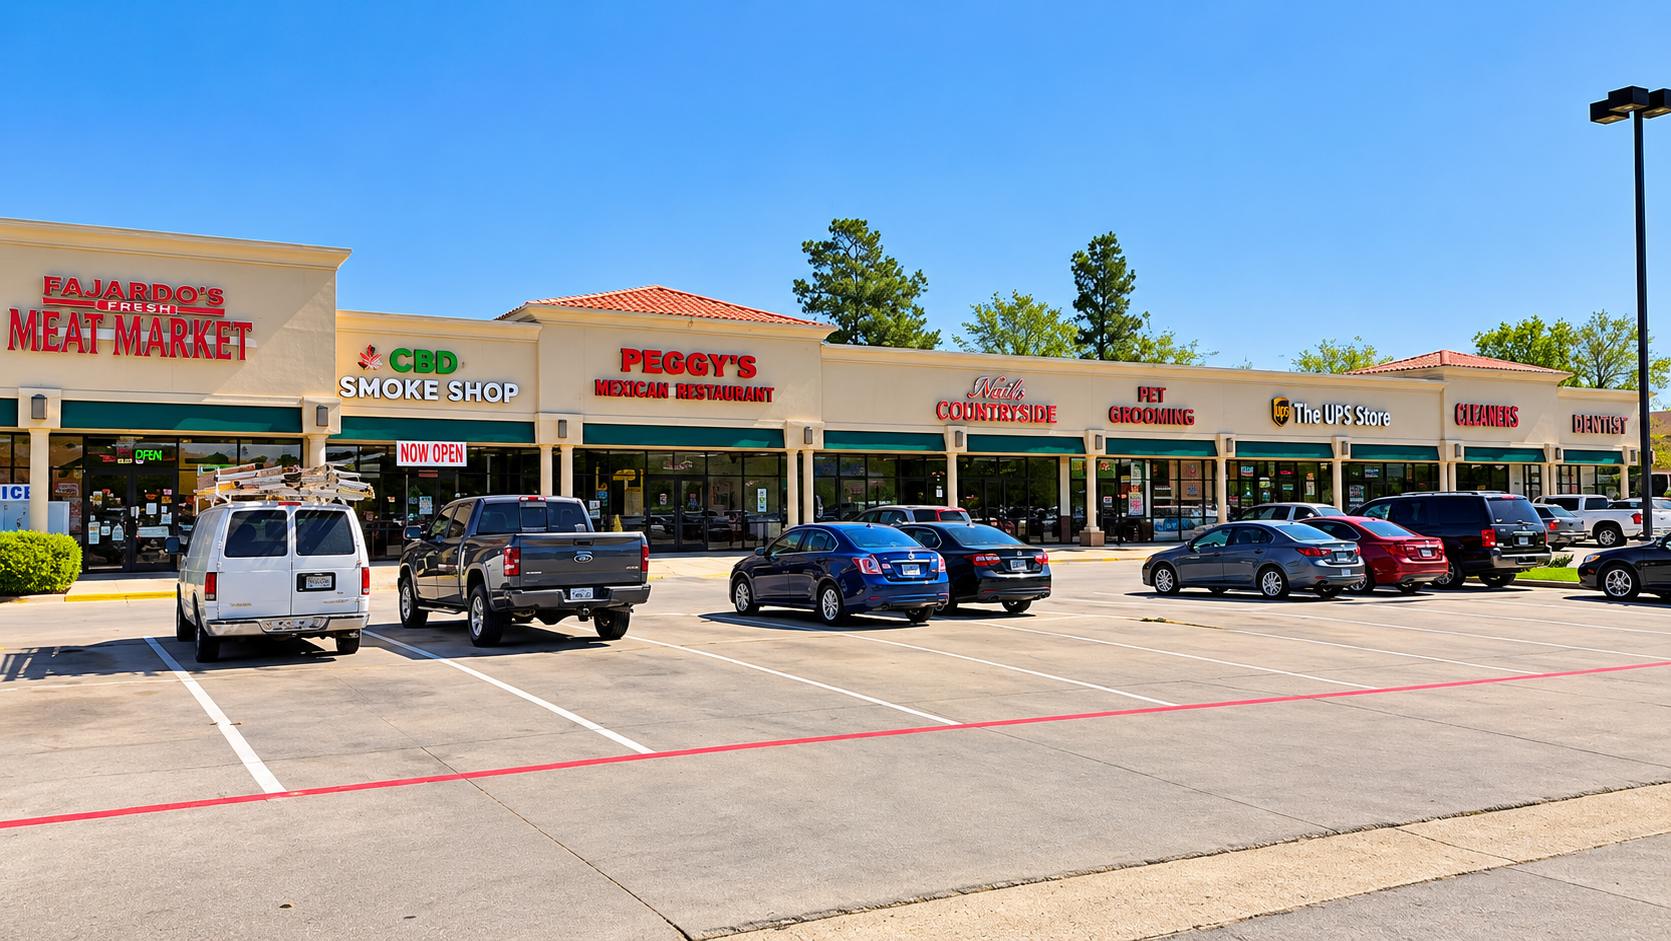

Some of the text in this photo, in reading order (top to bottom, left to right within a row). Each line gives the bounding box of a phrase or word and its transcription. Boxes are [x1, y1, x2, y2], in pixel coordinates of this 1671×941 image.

[43, 275, 225, 306] FAJARDO'S
[108, 301, 171, 315] FRESH
[8, 308, 253, 361] MEAT MARKET
[389, 347, 459, 375] CBD
[620, 348, 757, 379] PEGGY'S
[340, 376, 519, 403] SMOKE SHOP
[595, 379, 775, 402] MEXICAN RESTAURANT
[967, 375, 1025, 401] Nails
[1138, 386, 1167, 403] PET
[936, 401, 1057, 424] COUNTRYSIDE
[1109, 406, 1195, 425] GROOMING
[1293, 403, 1391, 427] The UPS Store
[1455, 403, 1519, 427] CLEANERS
[1572, 414, 1628, 434] DENTIST
[135, 449, 162, 460] OPEN
[400, 443, 464, 463] NOW OPEN
